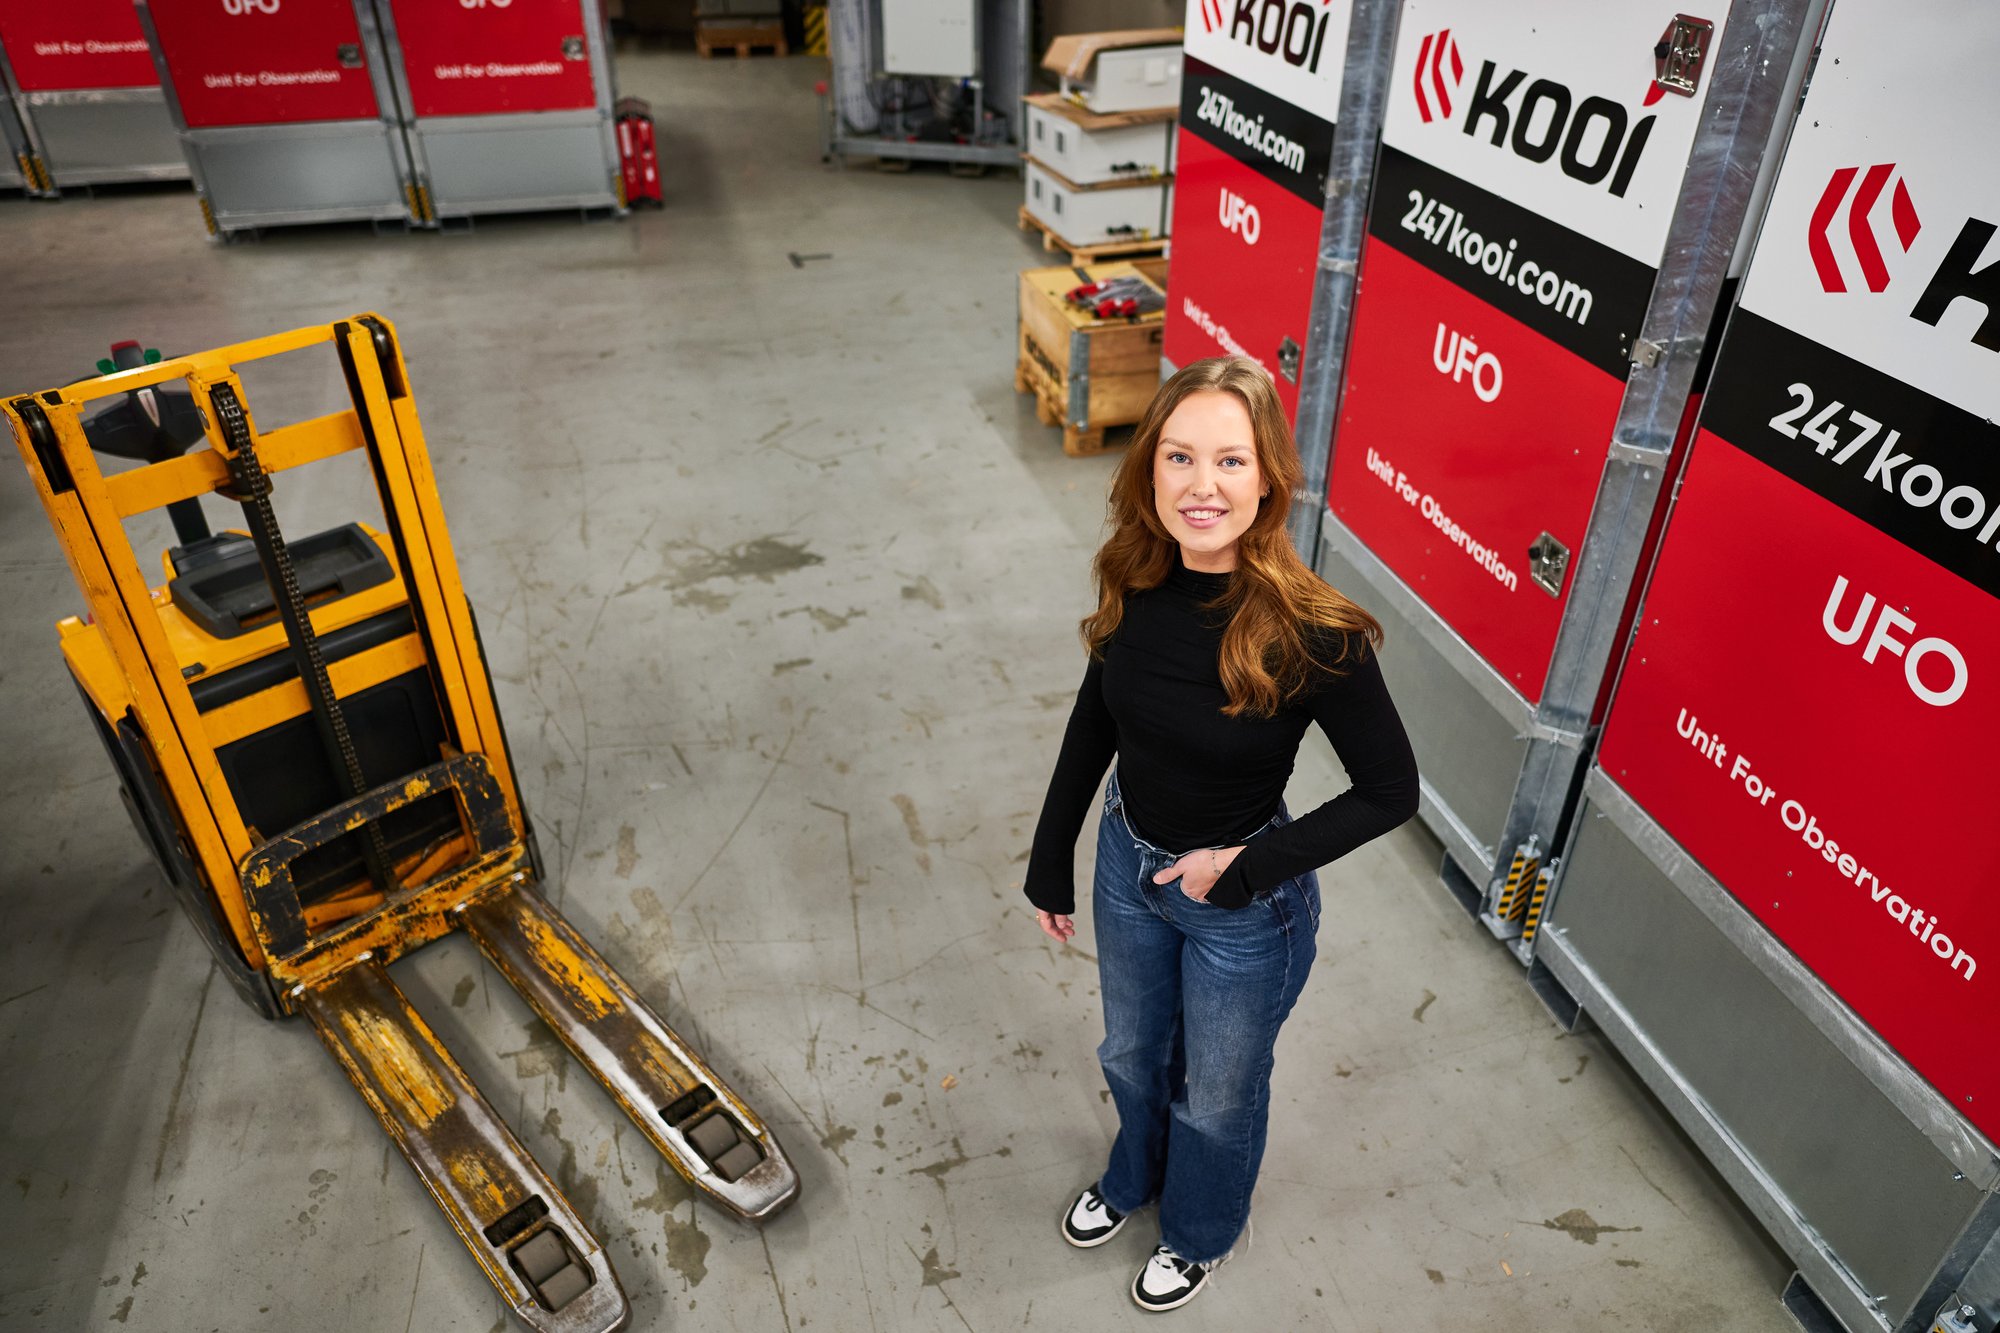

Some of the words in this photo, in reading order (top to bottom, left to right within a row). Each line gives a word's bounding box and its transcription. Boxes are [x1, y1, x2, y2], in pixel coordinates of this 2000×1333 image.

[34, 41, 62, 55] Unit
[63, 40, 83, 54] For
[204, 73, 233, 88] Unit
[234, 72, 256, 86] For
[258, 69, 340, 85] Observation
[435, 64, 462, 79] Unit
[463, 63, 484, 78] For
[485, 61, 563, 77] Observation
[1197, 86, 1305, 174] 247kooi.com
[1219, 188, 1261, 245] UFO
[1401, 190, 1593, 326] 247kooi.com
[1183, 296, 1203, 327] Unit
[1202, 311, 1217, 338] For
[1434, 323, 1502, 403] UFO
[1366, 447, 1396, 487] Unit
[1395, 471, 1420, 507] For
[1421, 495, 1518, 592] Observation
[1823, 575, 1968, 707] UFO
[1676, 708, 1727, 768] Unit
[1730, 755, 1776, 806] For
[1781, 800, 1977, 981] Observation
